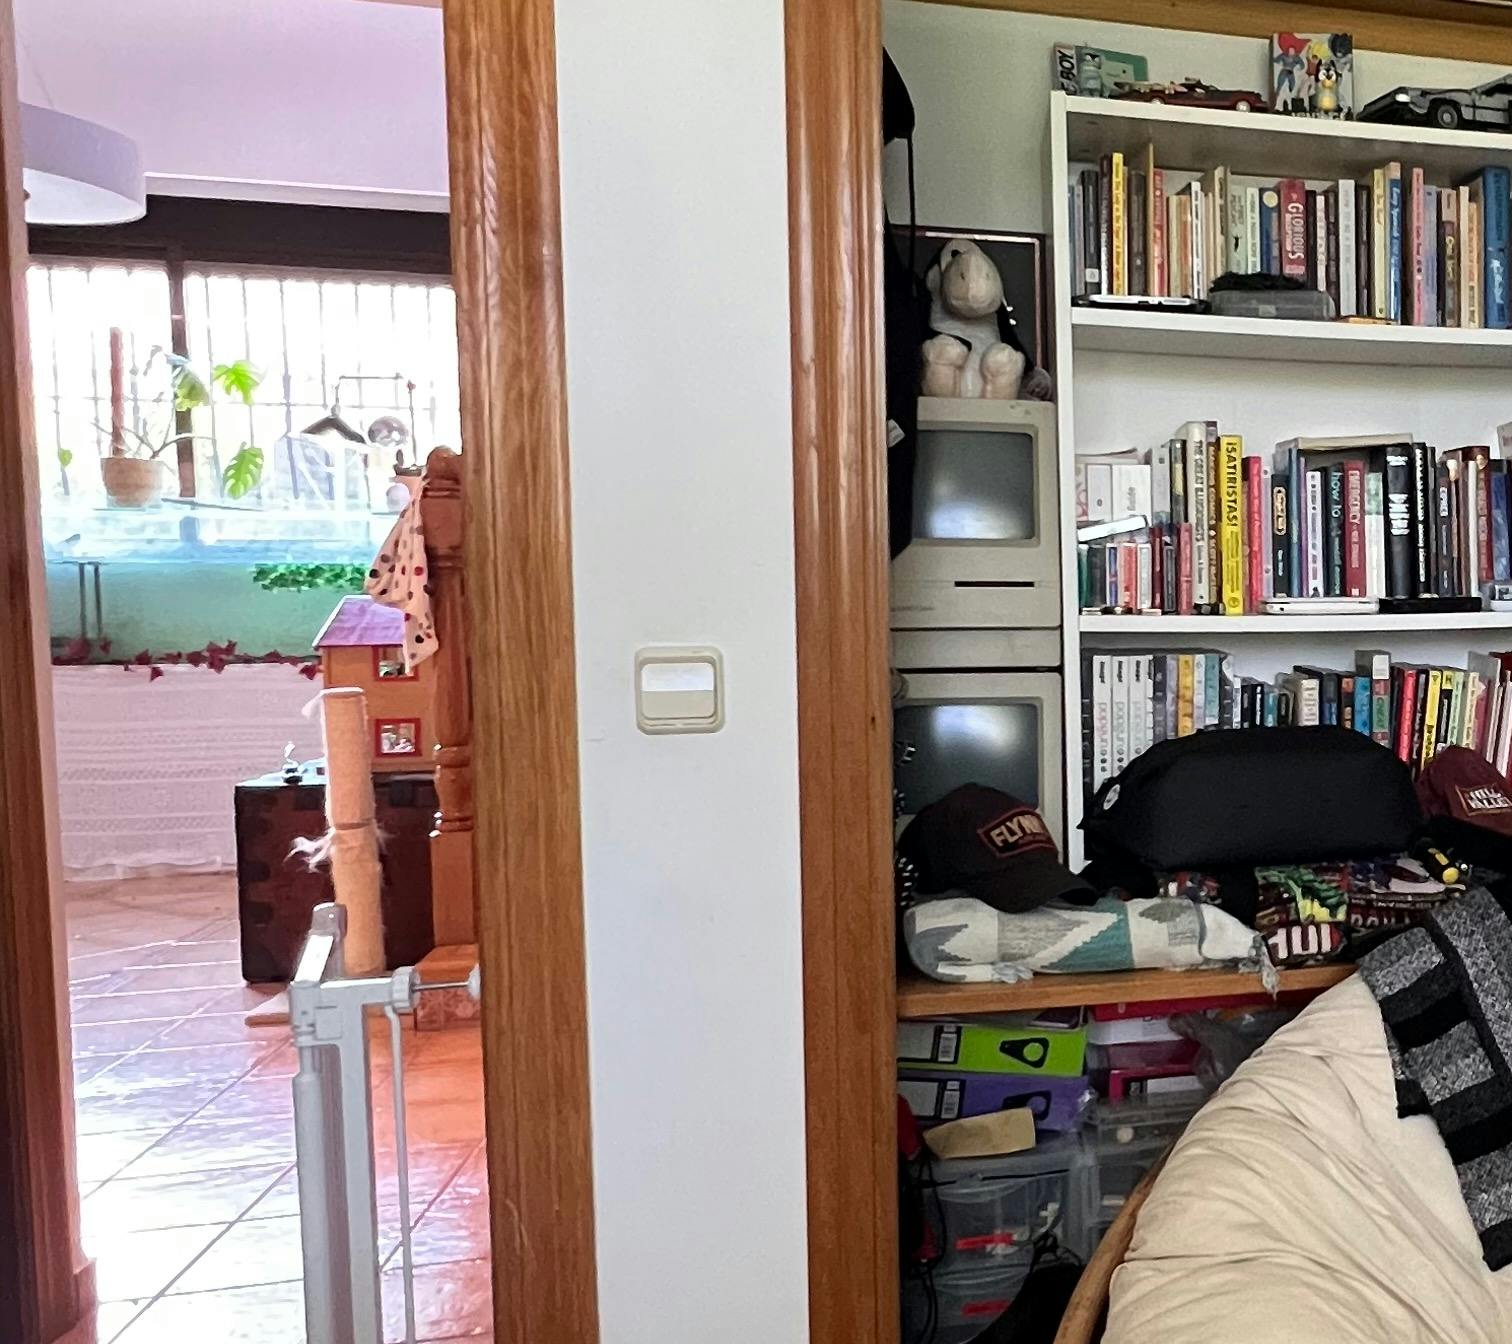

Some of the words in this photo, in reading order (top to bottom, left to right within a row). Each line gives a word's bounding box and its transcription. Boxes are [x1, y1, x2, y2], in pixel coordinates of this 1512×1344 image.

[1057, 50, 1076, 81] BOY
[1288, 203, 1304, 259] GLORIOUS
[1392, 207, 1401, 238] Spanish
[1194, 439, 1204, 456] THE
[1226, 442, 1239, 527] ¡SATIRISTAS!
[1331, 471, 1343, 501] how
[1332, 504, 1343, 518] to
[1376, 697, 1386, 729] CHEAT
